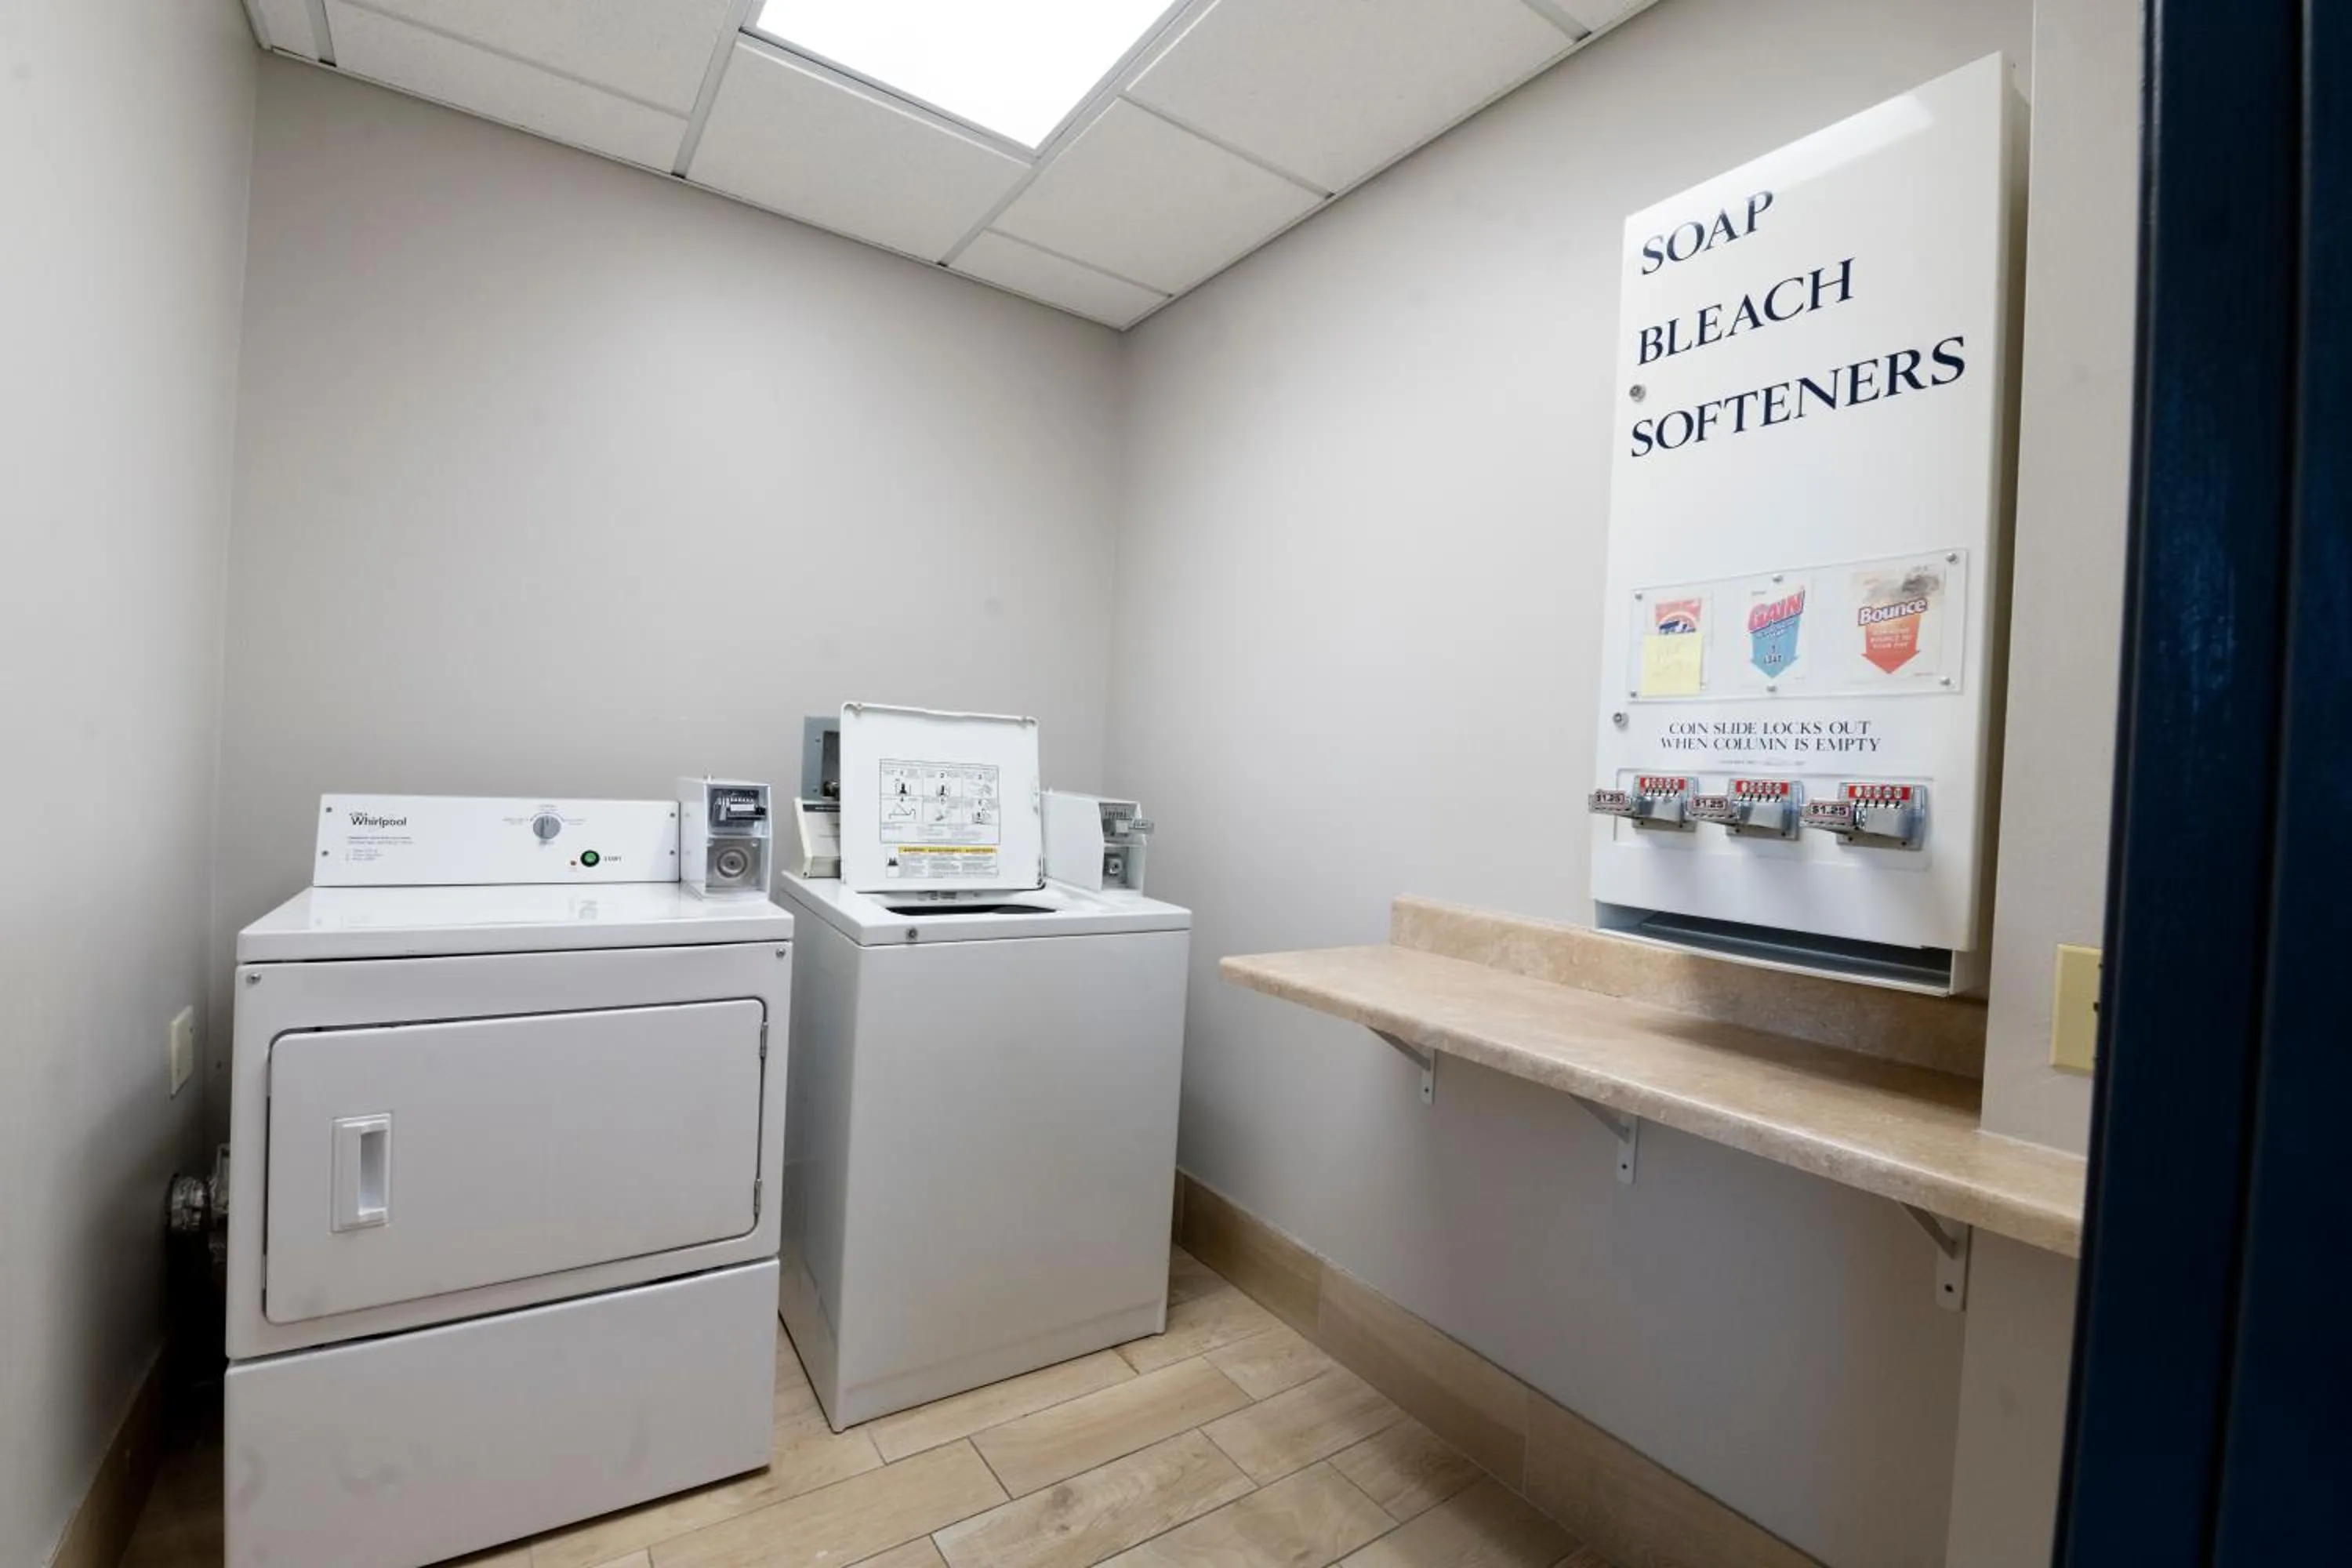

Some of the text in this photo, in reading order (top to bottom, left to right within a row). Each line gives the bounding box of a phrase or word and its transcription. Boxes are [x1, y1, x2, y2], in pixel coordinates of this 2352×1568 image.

[1641, 191, 1773, 275] SOAP
[1638, 257, 1855, 365] BLEACH
[1631, 336, 1965, 457] SOFTENERS
[1857, 597, 1928, 626] Bounce
[1668, 720, 1872, 735] COIN SLIDE LOCKS OUT
[1661, 737, 1882, 752] WHEN COLUMN IS EMPTY
[1595, 791, 1622, 804] $1.25
[1693, 798, 1725, 810] $1.25
[1809, 805, 1846, 816] $1.25
[351, 816, 408, 828] Whirlpool
